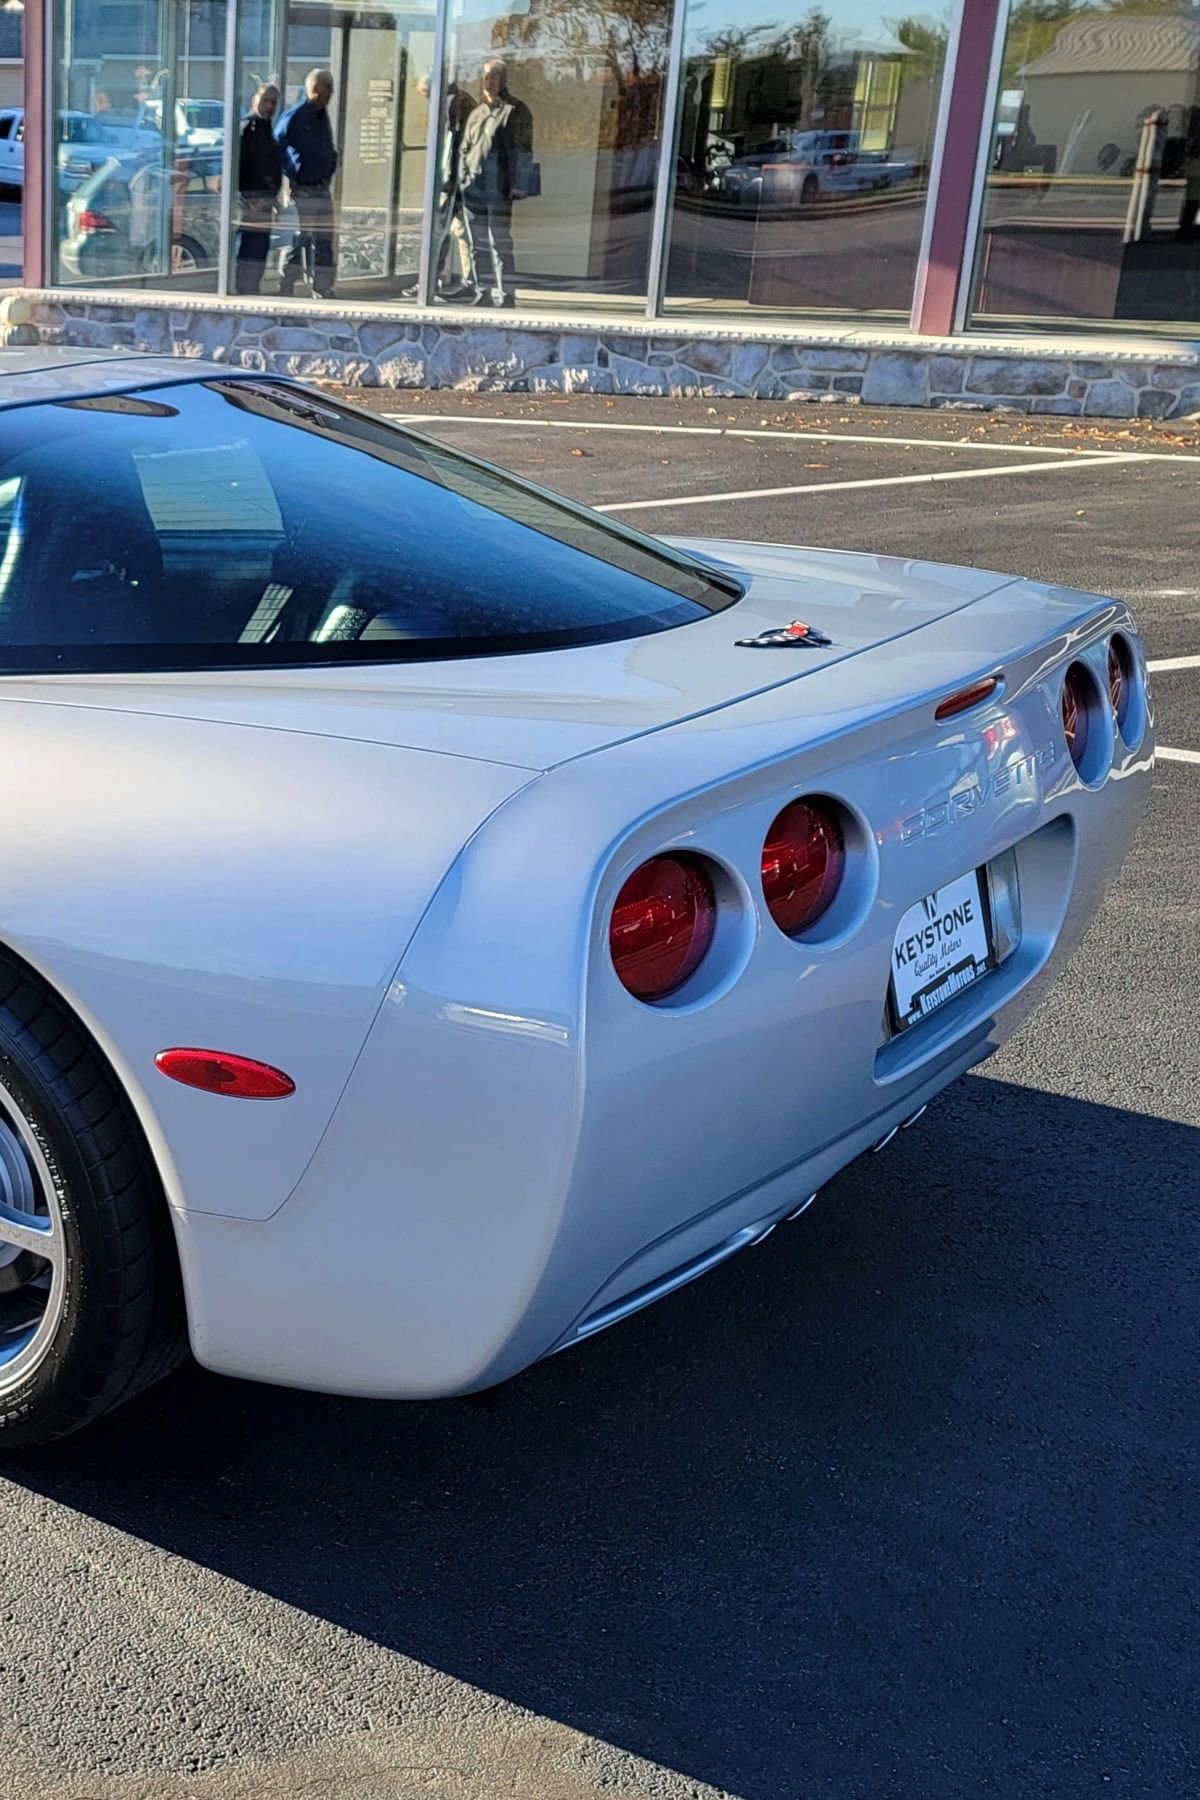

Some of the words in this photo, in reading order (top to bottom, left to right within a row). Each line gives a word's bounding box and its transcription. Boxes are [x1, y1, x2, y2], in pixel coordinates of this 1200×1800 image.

[900, 740, 1055, 848] CORVETTE
[894, 898, 974, 970] KEYSTONE
[914, 953, 938, 977] Quality
[940, 938, 962, 961] Motors
